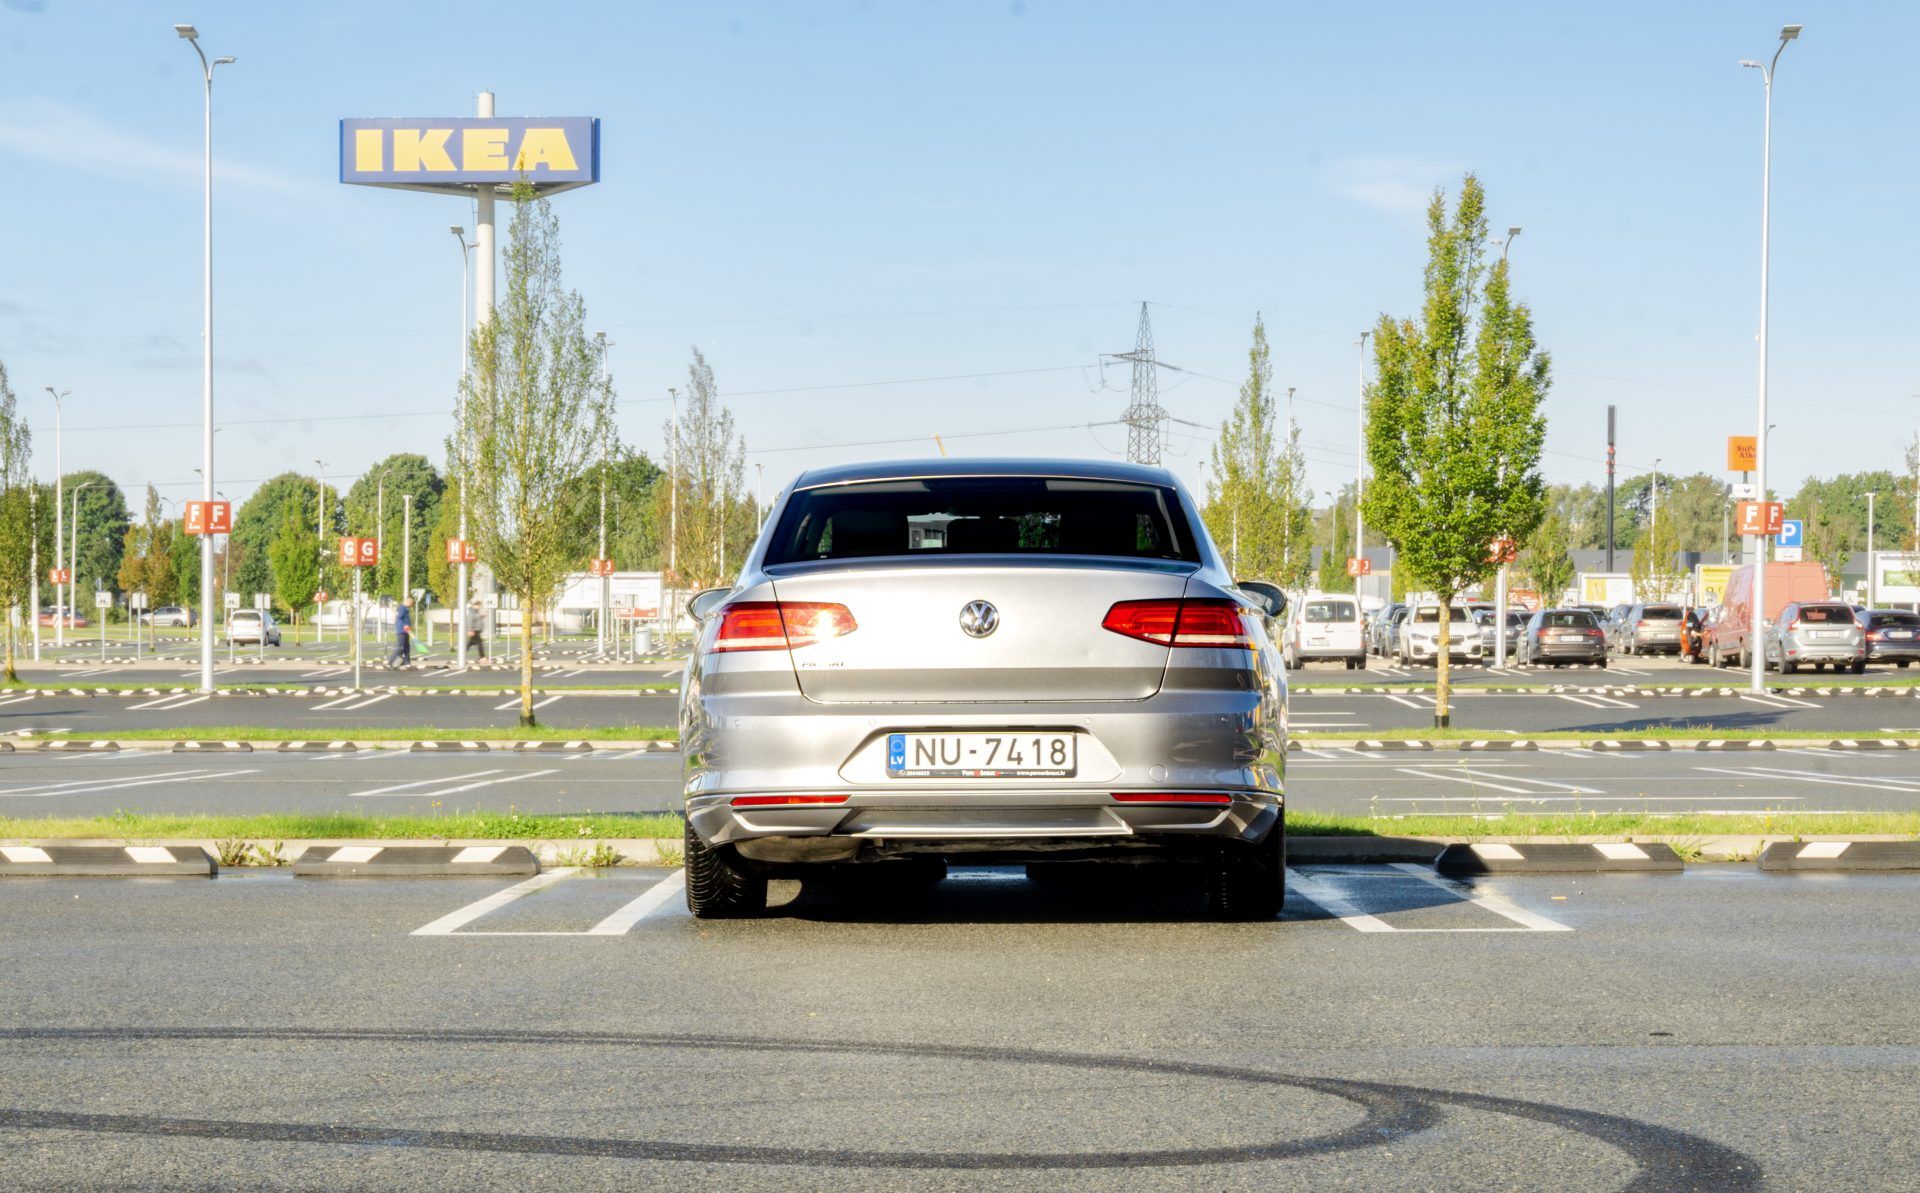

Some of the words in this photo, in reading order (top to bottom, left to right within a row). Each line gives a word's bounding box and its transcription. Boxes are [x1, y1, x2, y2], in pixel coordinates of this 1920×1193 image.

[355, 128, 579, 172] IKEA
[191, 504, 200, 522] F
[212, 504, 224, 522] F
[1746, 505, 1758, 523] F
[1770, 505, 1779, 523] F
[1781, 524, 1796, 544] P
[344, 541, 354, 555] G
[362, 541, 373, 555] G
[450, 541, 459, 555] H
[891, 756, 904, 764] LV
[915, 738, 1066, 766] NU-7418
